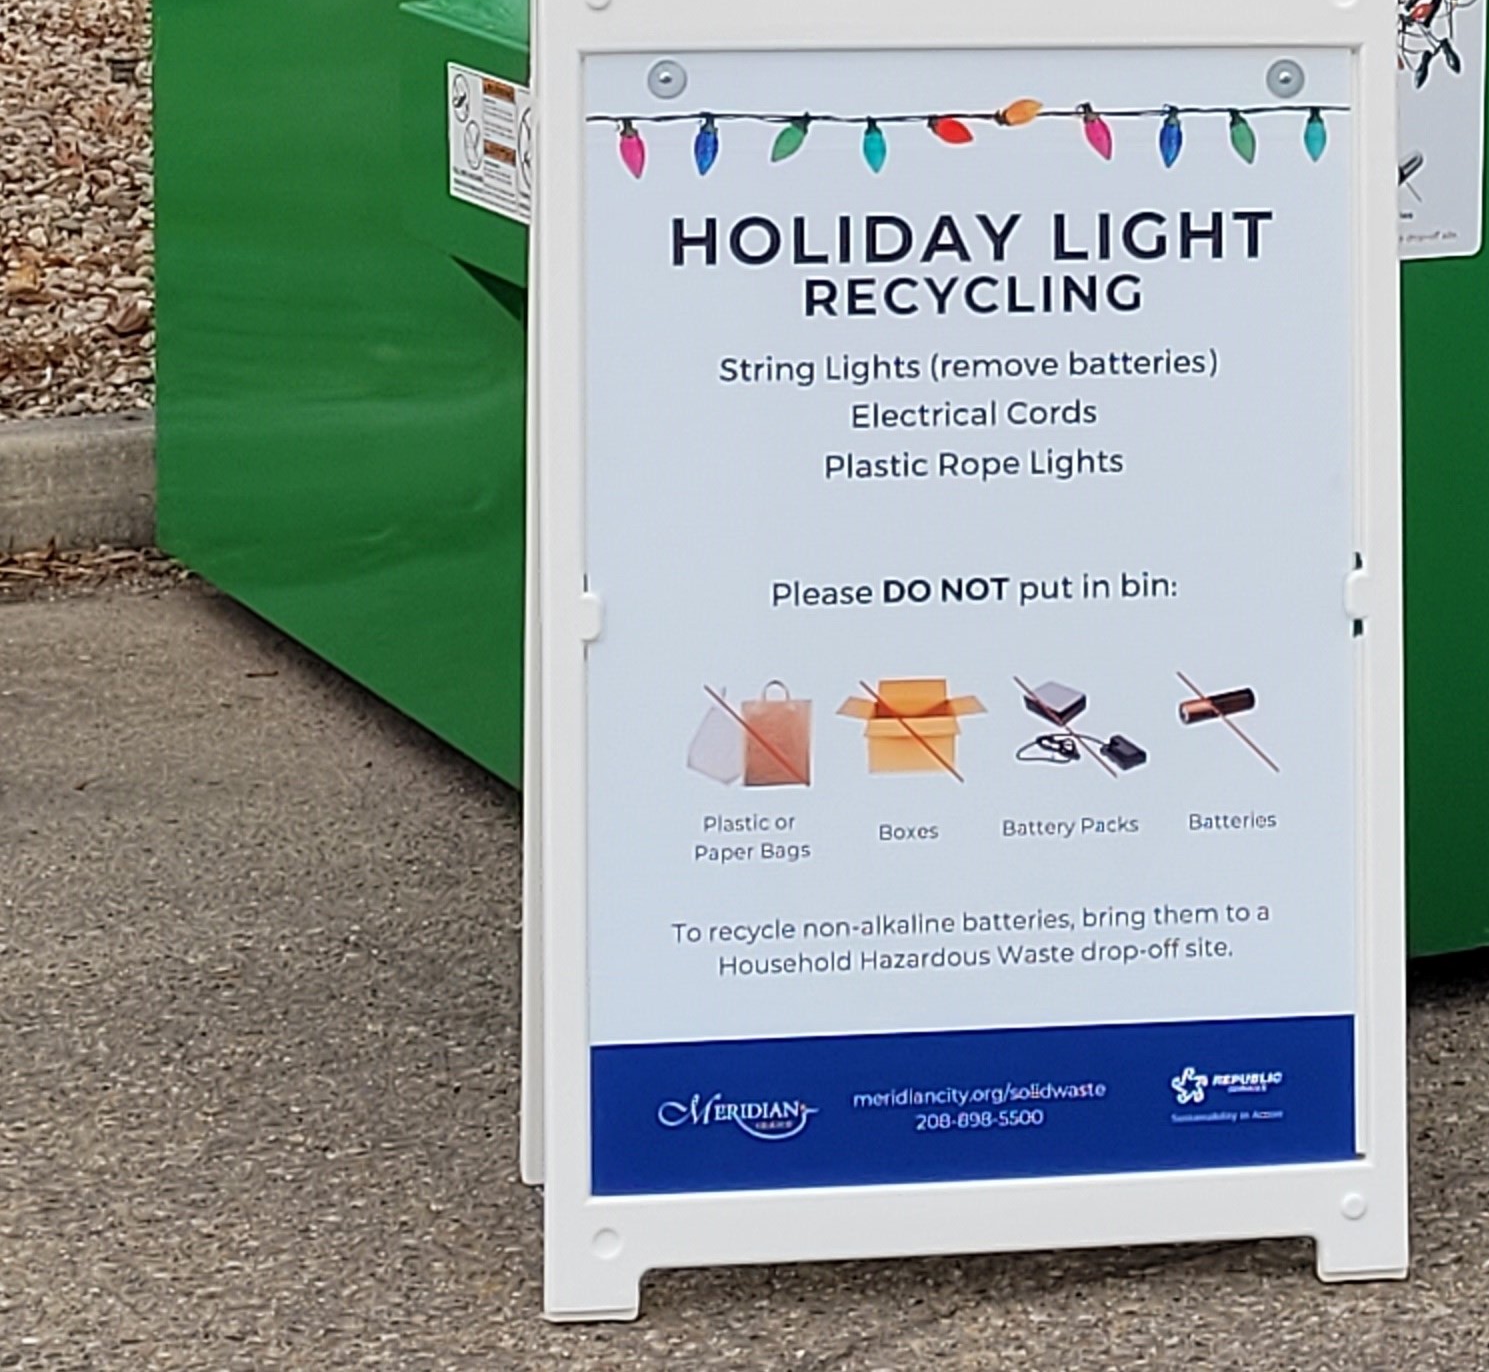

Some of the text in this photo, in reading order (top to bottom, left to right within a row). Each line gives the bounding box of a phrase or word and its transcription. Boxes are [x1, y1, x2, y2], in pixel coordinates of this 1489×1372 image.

[672, 210, 1274, 266] HOLIDAY LIGHT
[804, 274, 1143, 317] RECYCLING
[719, 348, 1219, 388] String Lights (remove batteries)
[851, 399, 1097, 429] Electrical Cords
[824, 448, 1124, 483] Plastic Rope Lights
[772, 571, 1178, 608] Please DO NOT put in bin:
[702, 814, 796, 833] Plastic or
[878, 821, 939, 841] Boxes
[1002, 815, 1140, 840] Battery Packs
[1188, 811, 1278, 832] Batteries
[694, 841, 811, 867] Paper Bags
[672, 903, 1271, 946] To recycle non-alkaline batteries, bring them to a
[718, 936, 1234, 977] Household Hazardous Waste drop-off site.
[658, 1092, 800, 1126] MERIDIAN
[853, 1082, 1107, 1107] meridiancity.org/solidwaste
[914, 1109, 1045, 1131] 208-898-5500
